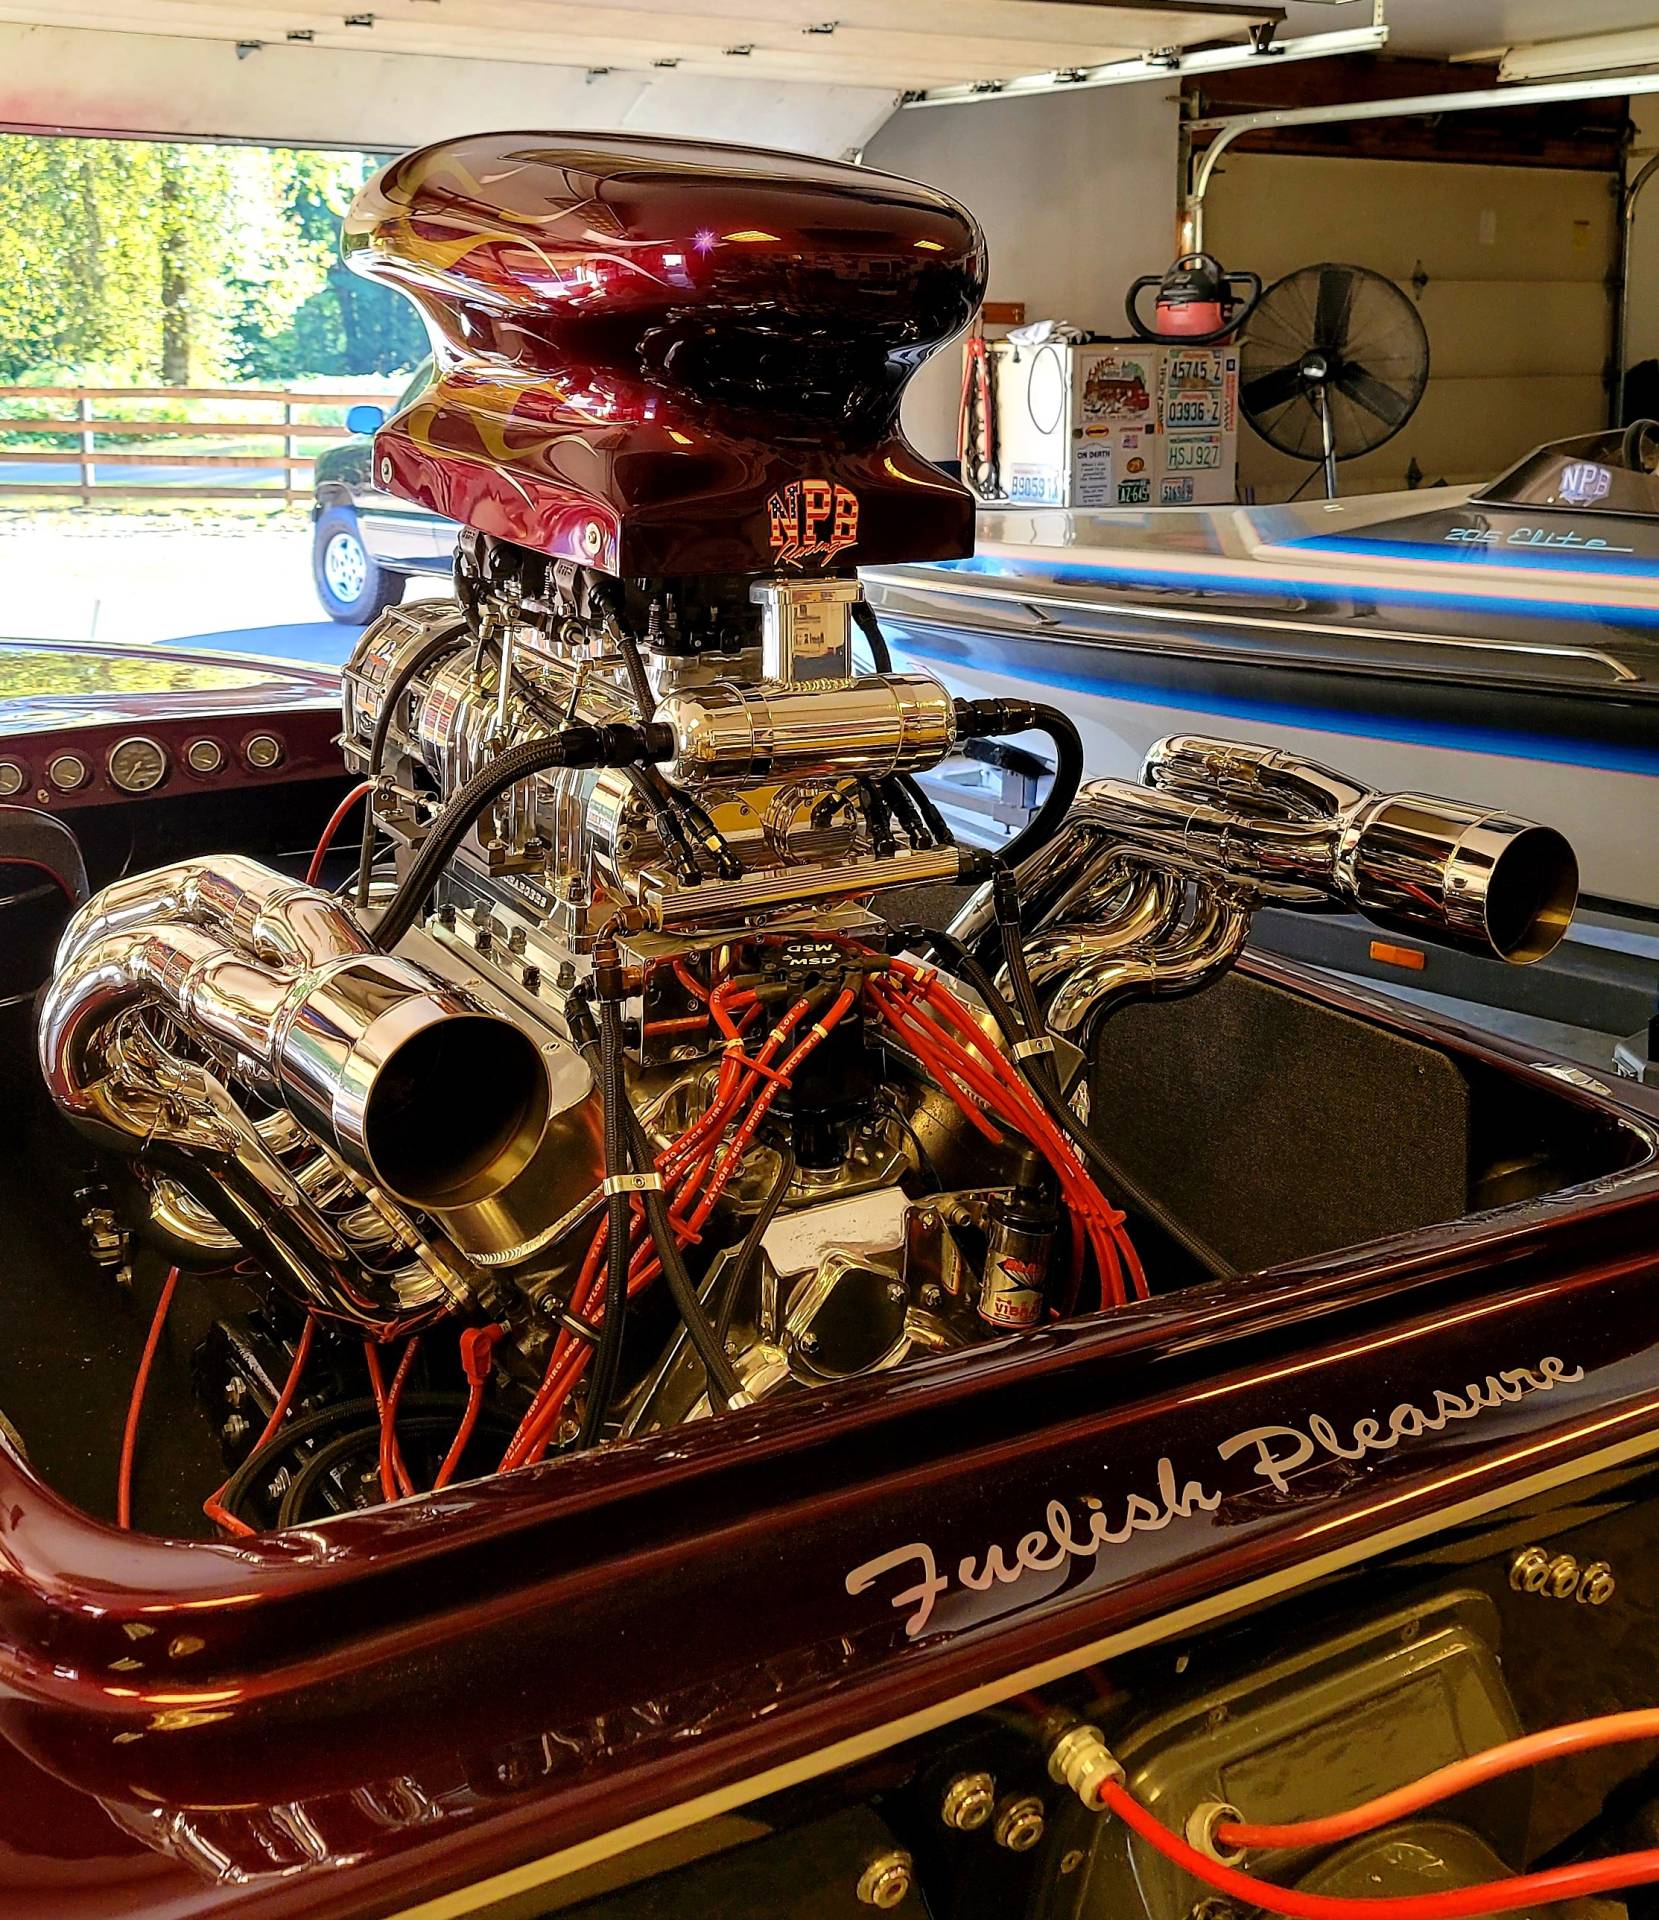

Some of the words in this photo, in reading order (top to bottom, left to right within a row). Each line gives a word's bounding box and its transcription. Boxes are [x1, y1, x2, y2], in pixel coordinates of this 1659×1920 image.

[1169, 446, 1194, 466] HSJ
[1196, 446, 1219, 465] 927
[1560, 463, 1612, 498] NPB
[768, 479, 859, 547] NPB
[1444, 528, 1503, 544] 205
[1507, 527, 1634, 553] Elite
[789, 957, 837, 966] MSD
[680, 1128, 703, 1150] RACE
[704, 1166, 730, 1206] TAYLOR
[745, 1103, 765, 1133] SPIRO
[582, 1276, 605, 1316] TAYLOR
[846, 1458, 1222, 1636] Fuelish
[1217, 1356, 1585, 1494] Pleasure
